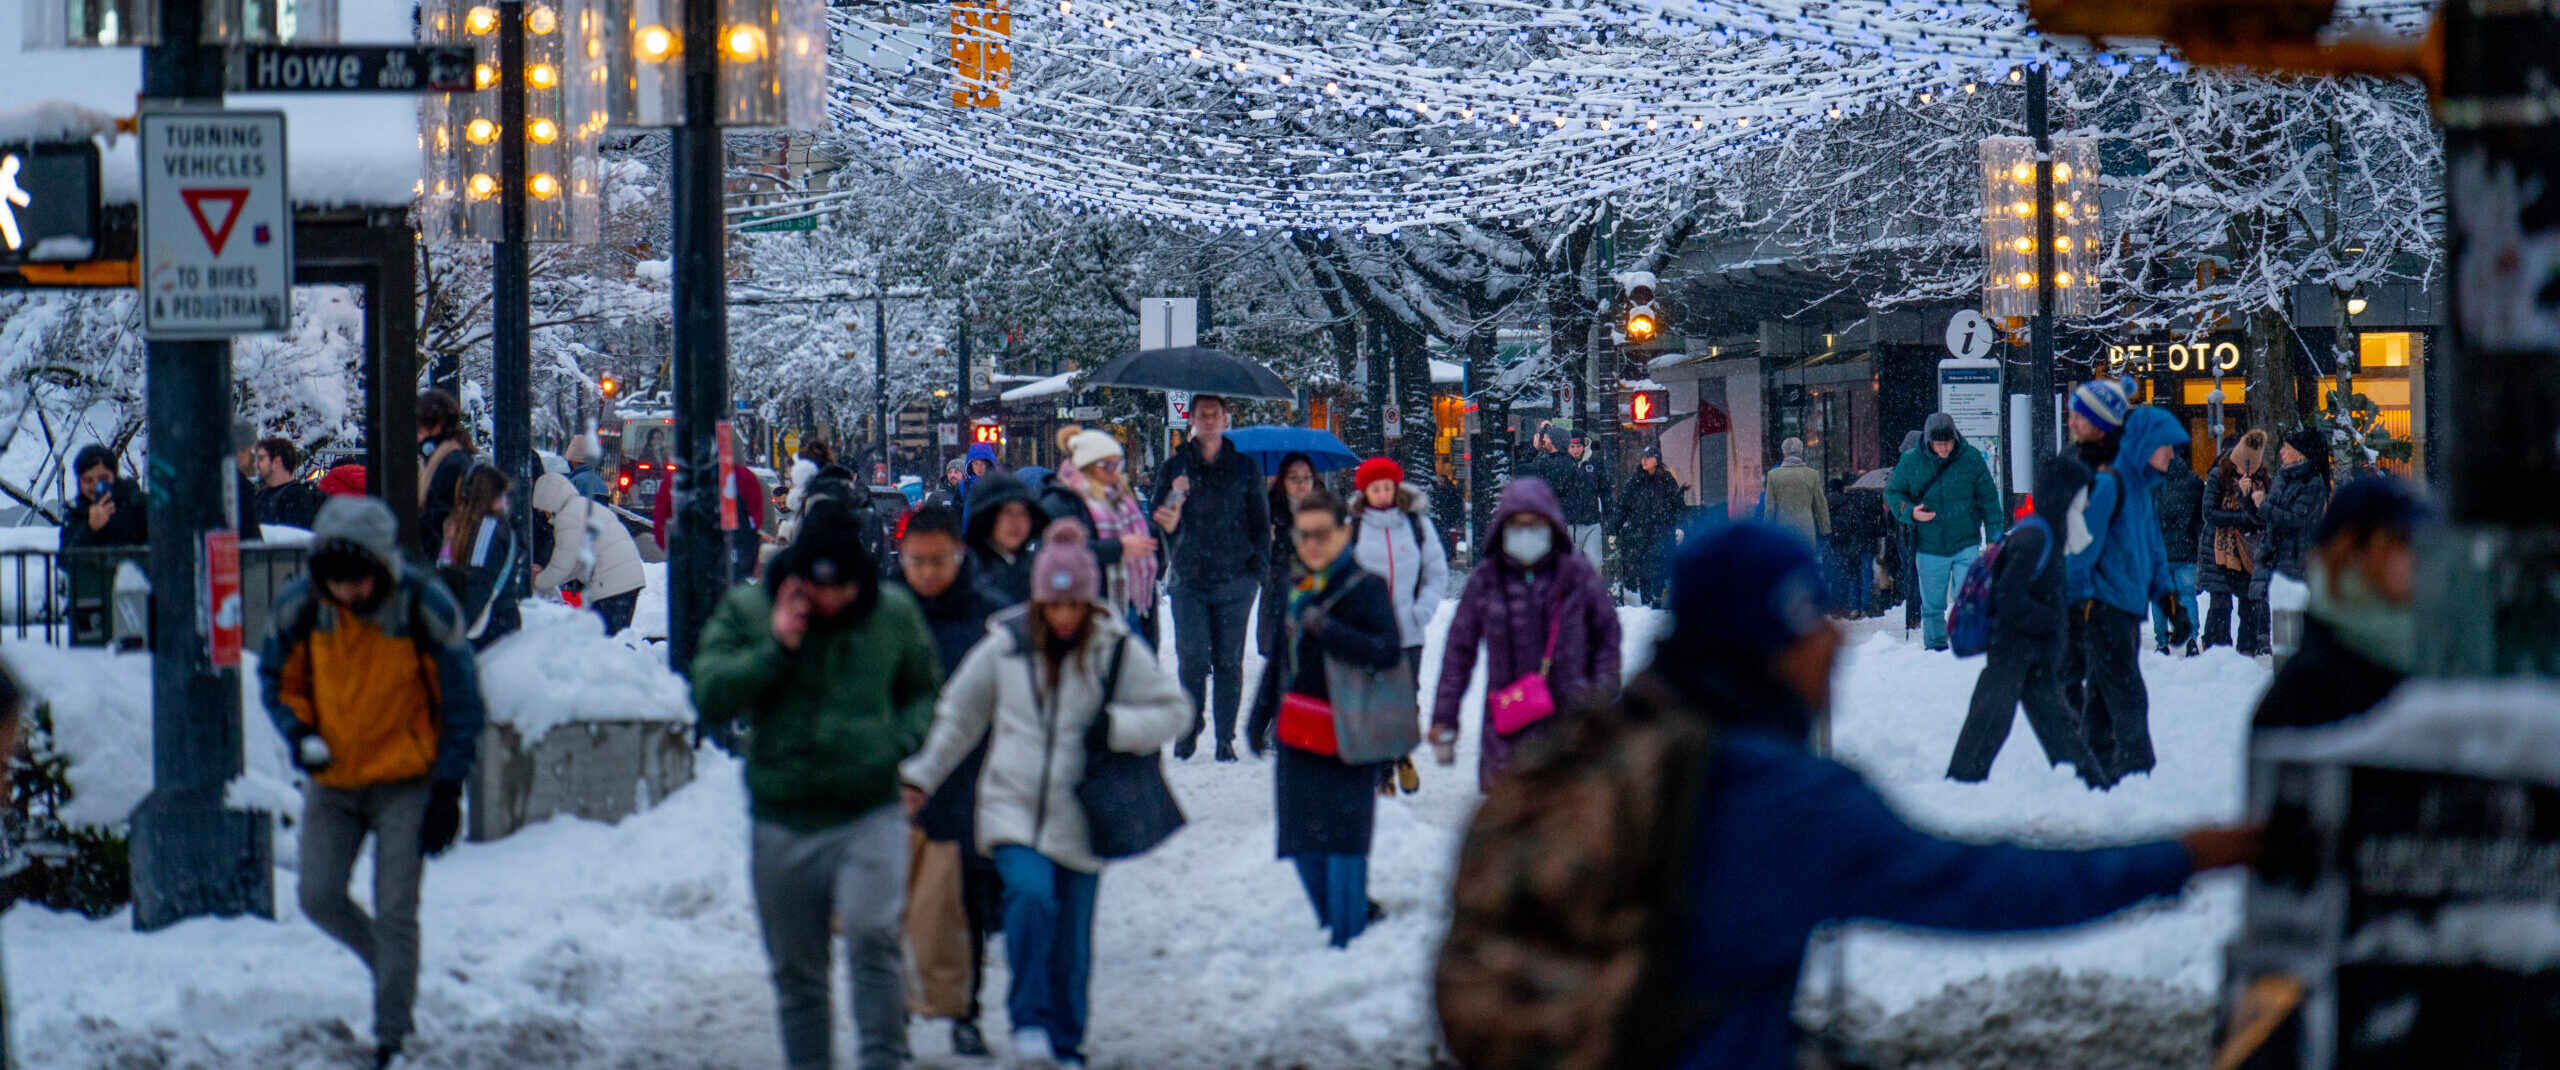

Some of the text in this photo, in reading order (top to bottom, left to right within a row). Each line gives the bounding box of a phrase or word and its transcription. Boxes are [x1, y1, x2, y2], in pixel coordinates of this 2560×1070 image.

[257, 51, 361, 88] Howe
[164, 124, 262, 148] TURNING
[164, 154, 266, 177] VEHICLES
[176, 264, 258, 290] TO BIKES
